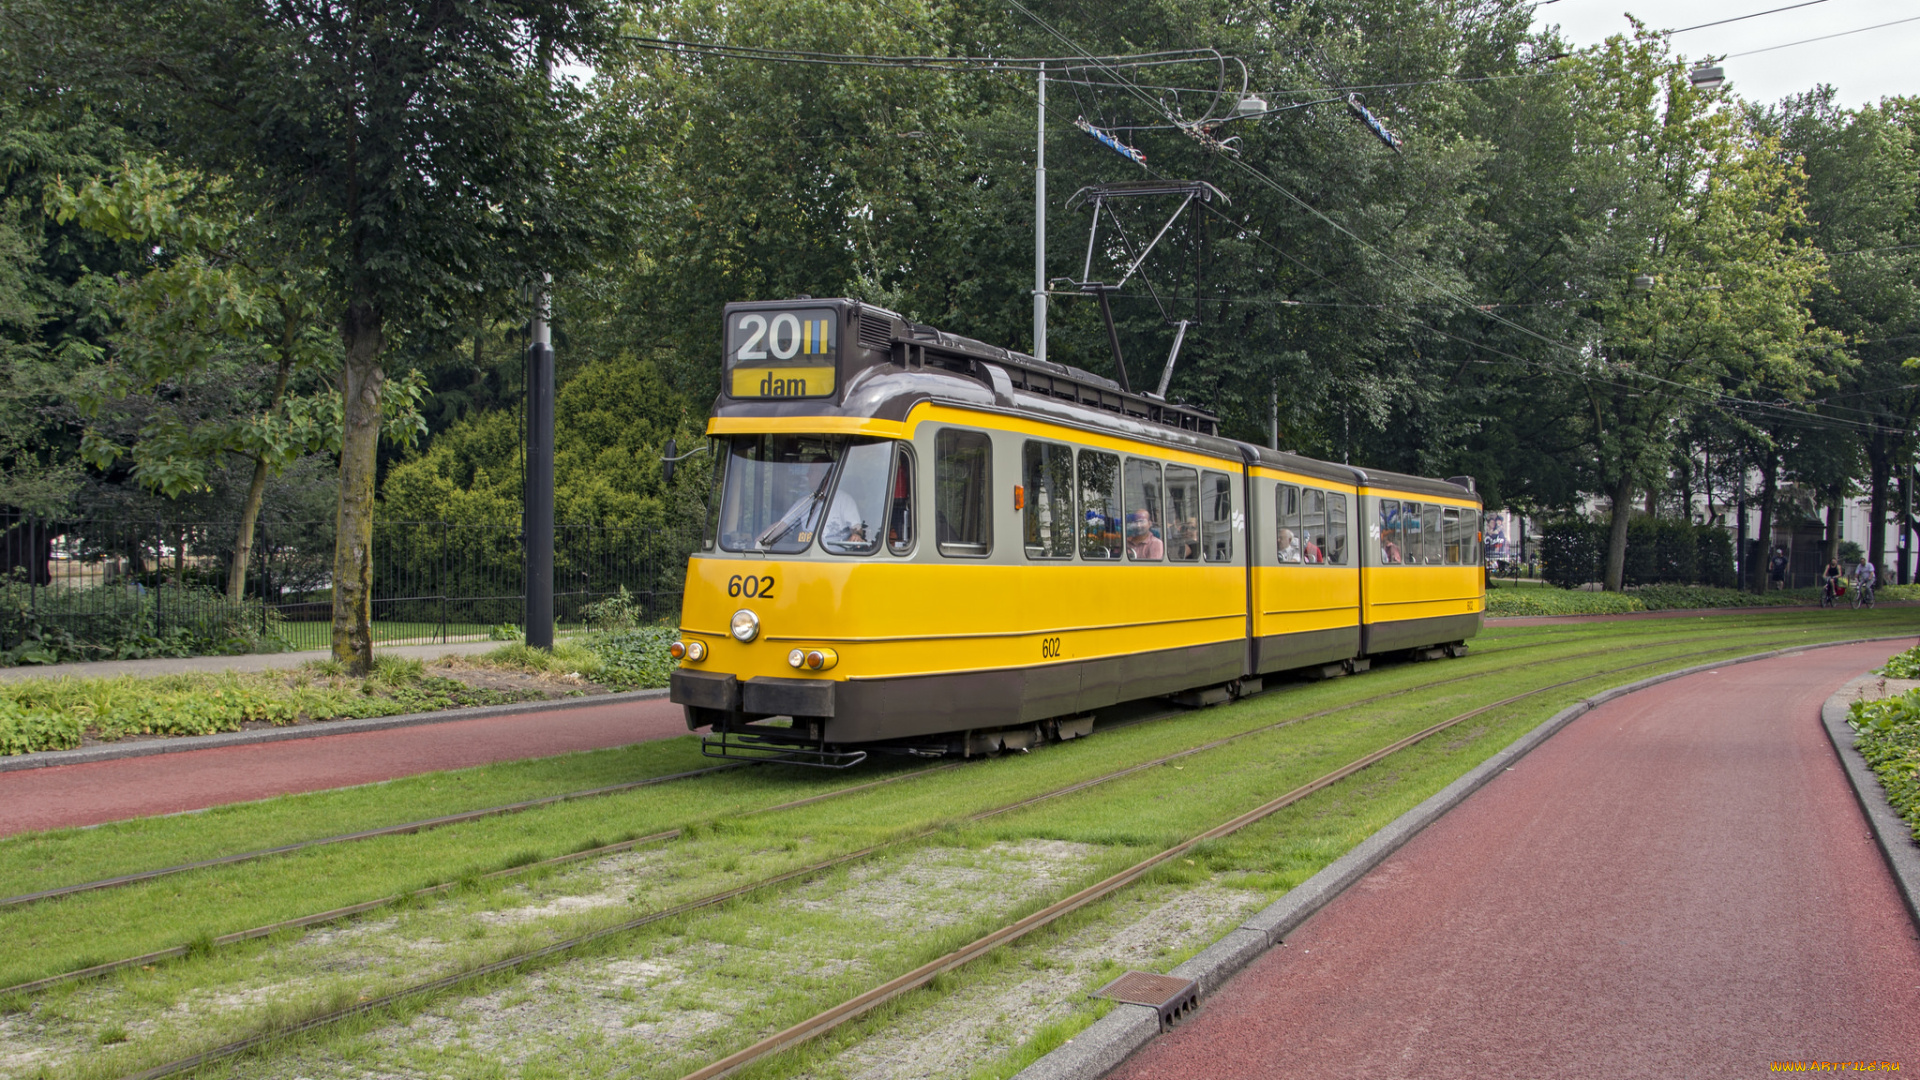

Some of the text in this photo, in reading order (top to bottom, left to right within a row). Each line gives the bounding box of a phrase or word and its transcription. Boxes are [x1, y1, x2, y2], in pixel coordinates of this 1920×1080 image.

[738, 313, 801, 360] 20
[760, 371, 806, 397] dam
[727, 574, 775, 598] 602
[1042, 637, 1061, 658] 602
